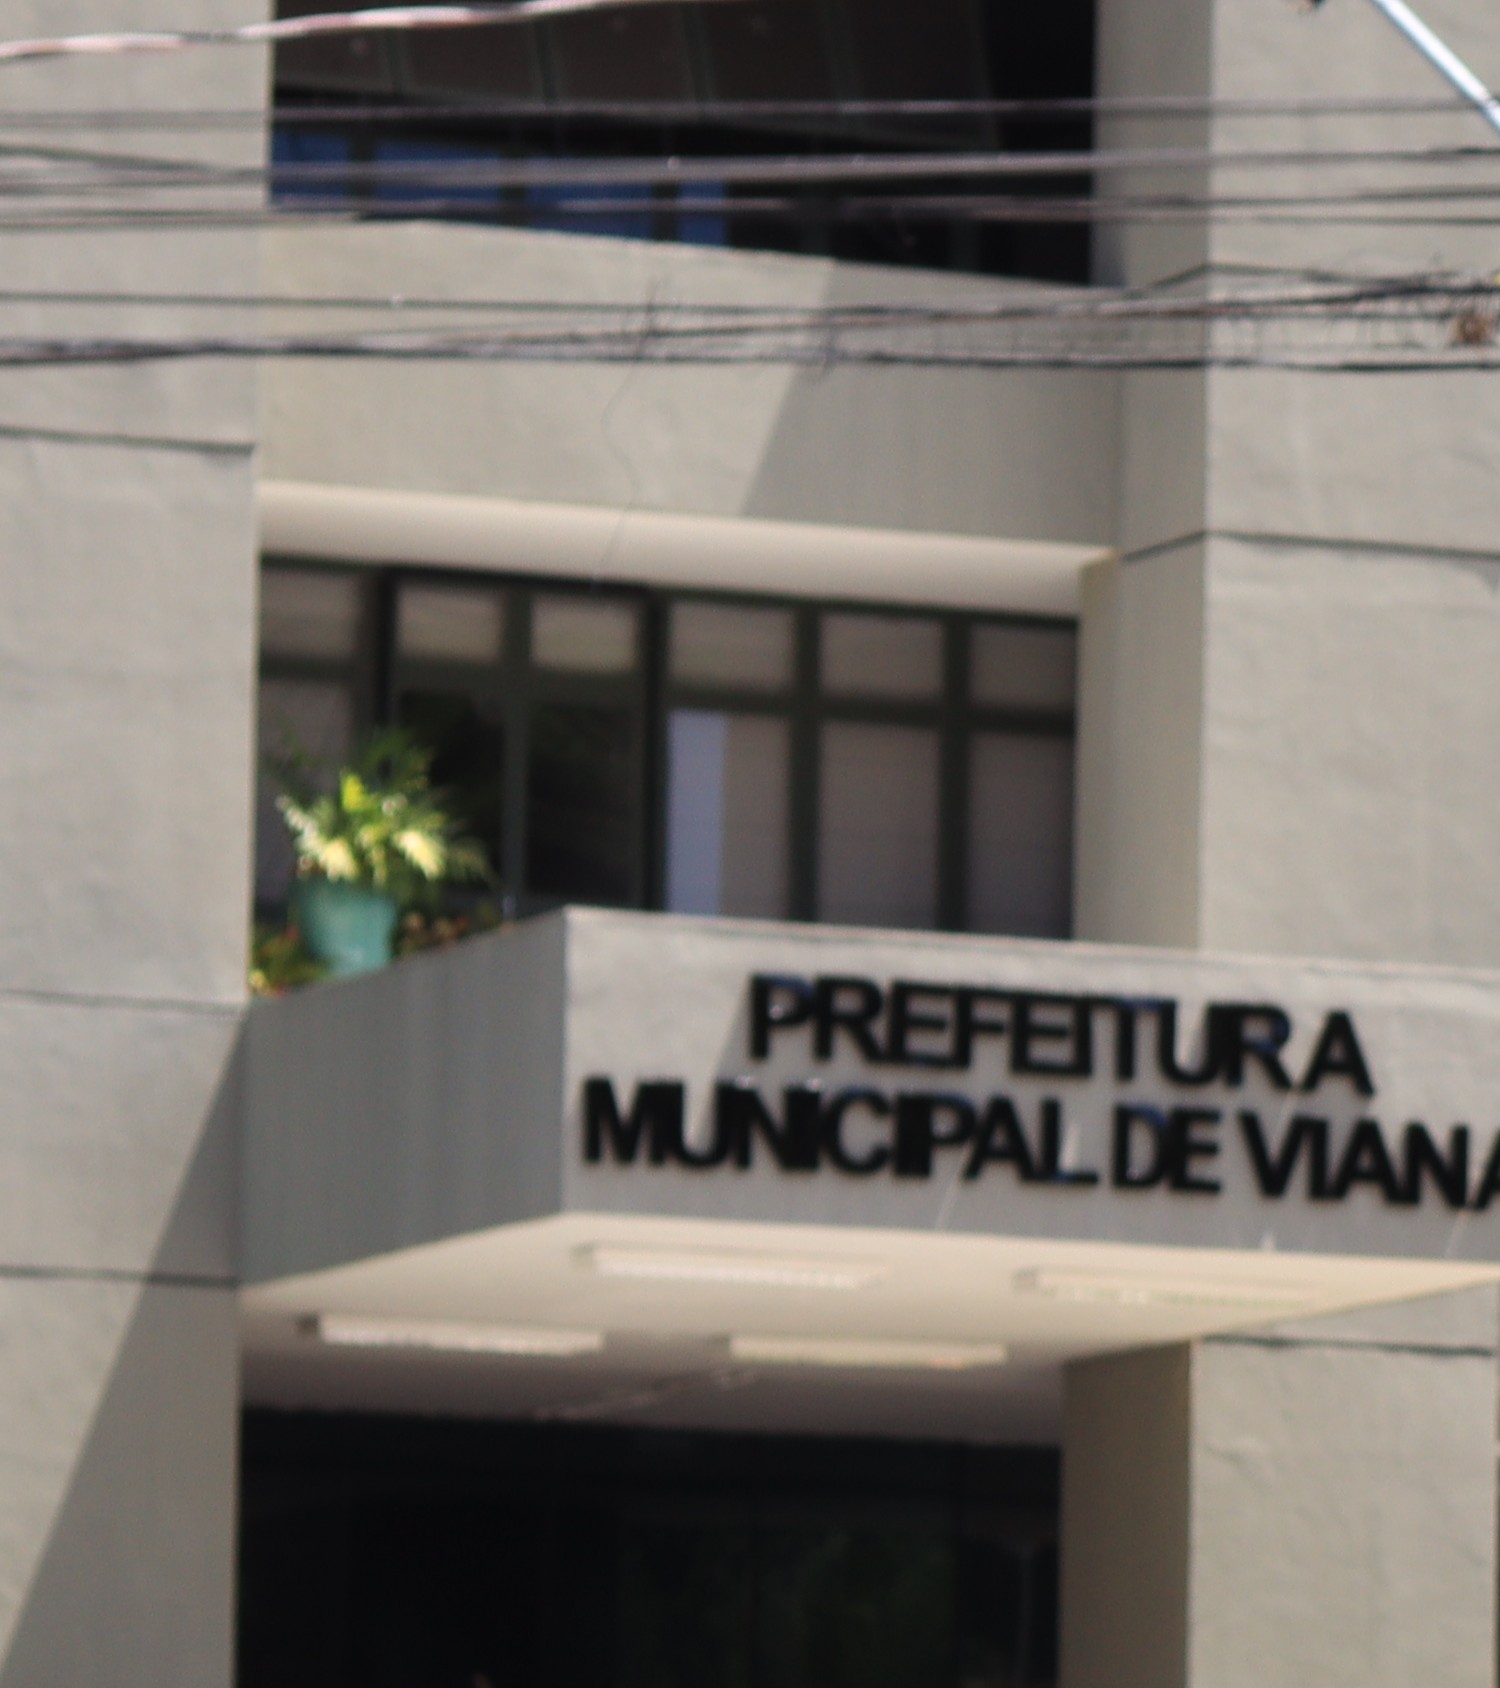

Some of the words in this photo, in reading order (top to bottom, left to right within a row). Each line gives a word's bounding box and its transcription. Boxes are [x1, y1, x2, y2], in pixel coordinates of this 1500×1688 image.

[748, 975, 1374, 1097] PREFEITURA
[582, 1076, 1099, 1189] MUNICIPAL
[1111, 1103, 1223, 1193] DE
